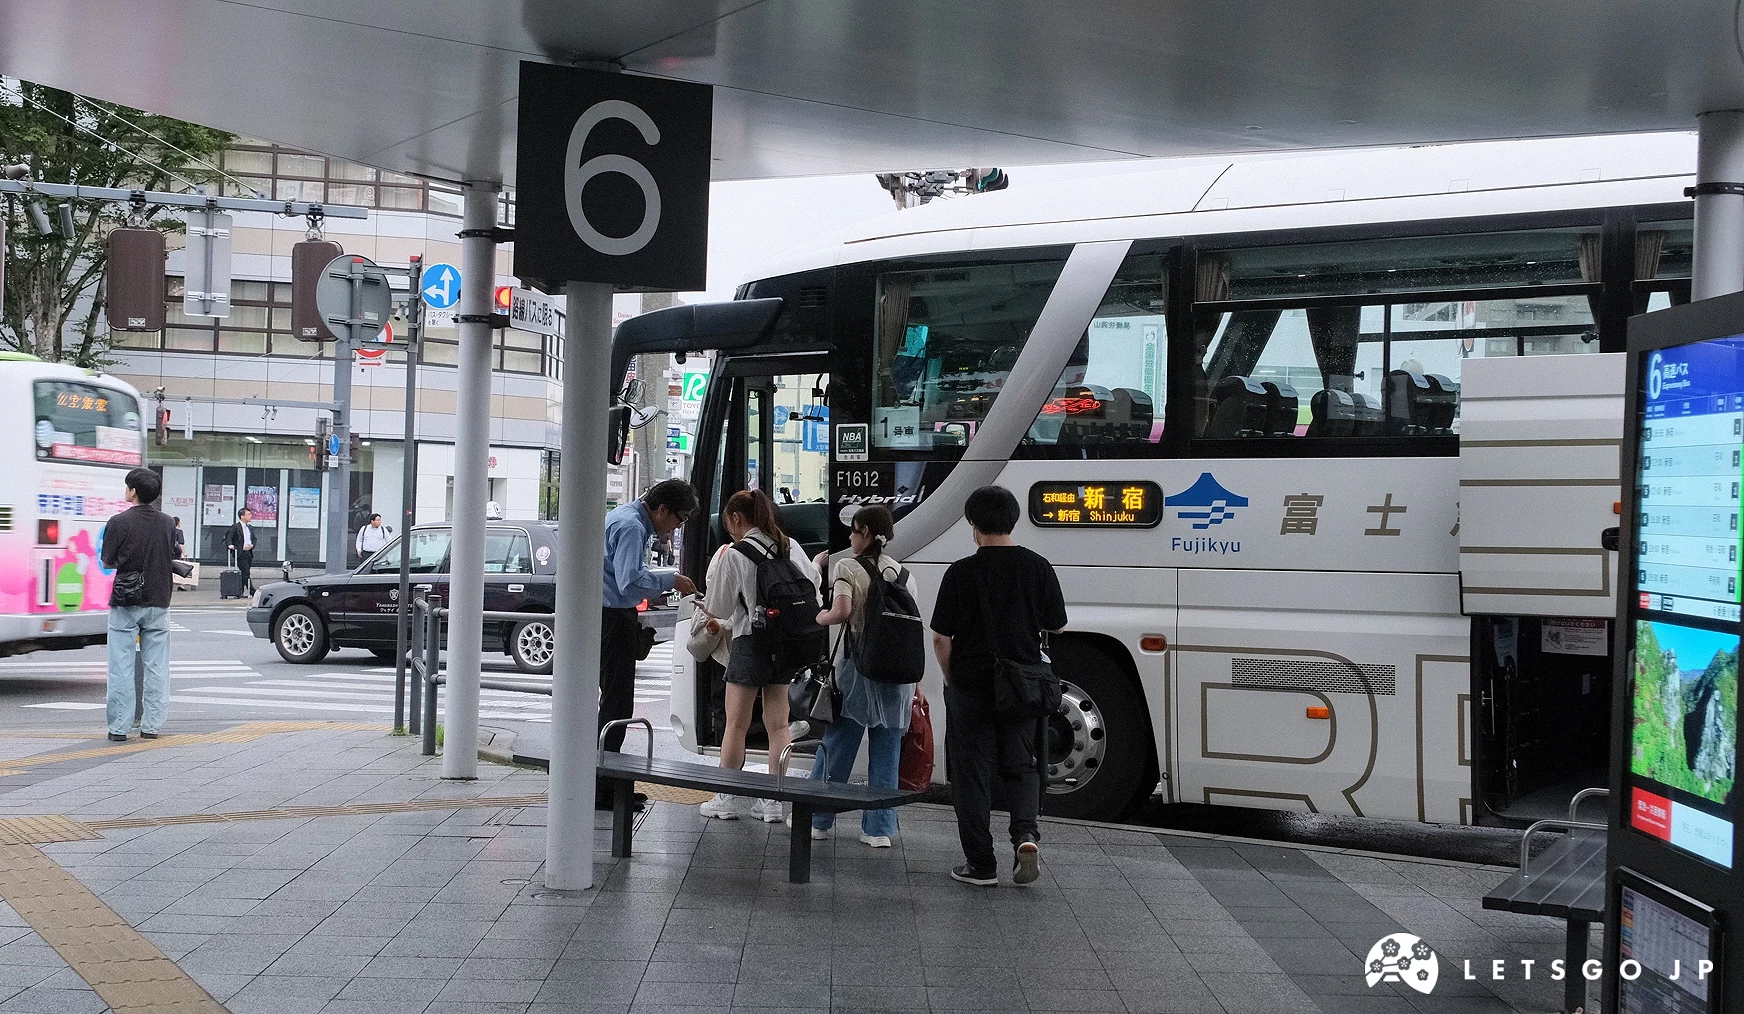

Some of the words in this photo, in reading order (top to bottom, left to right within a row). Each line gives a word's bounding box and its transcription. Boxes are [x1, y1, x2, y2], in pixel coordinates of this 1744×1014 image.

[564, 100, 661, 256] 6
[1650, 353, 1662, 400] 6
[880, 416, 888, 438] 1
[843, 432, 861, 441] NBA
[837, 471, 879, 487] F1612
[837, 494, 917, 506] Hybrid
[1042, 493, 1075, 503] 石和経由
[1084, 486, 1144, 510] 新宿
[1057, 509, 1080, 522] 新宿
[1089, 511, 1135, 522] Shinjuku
[1171, 537, 1240, 555] Fujikyu
